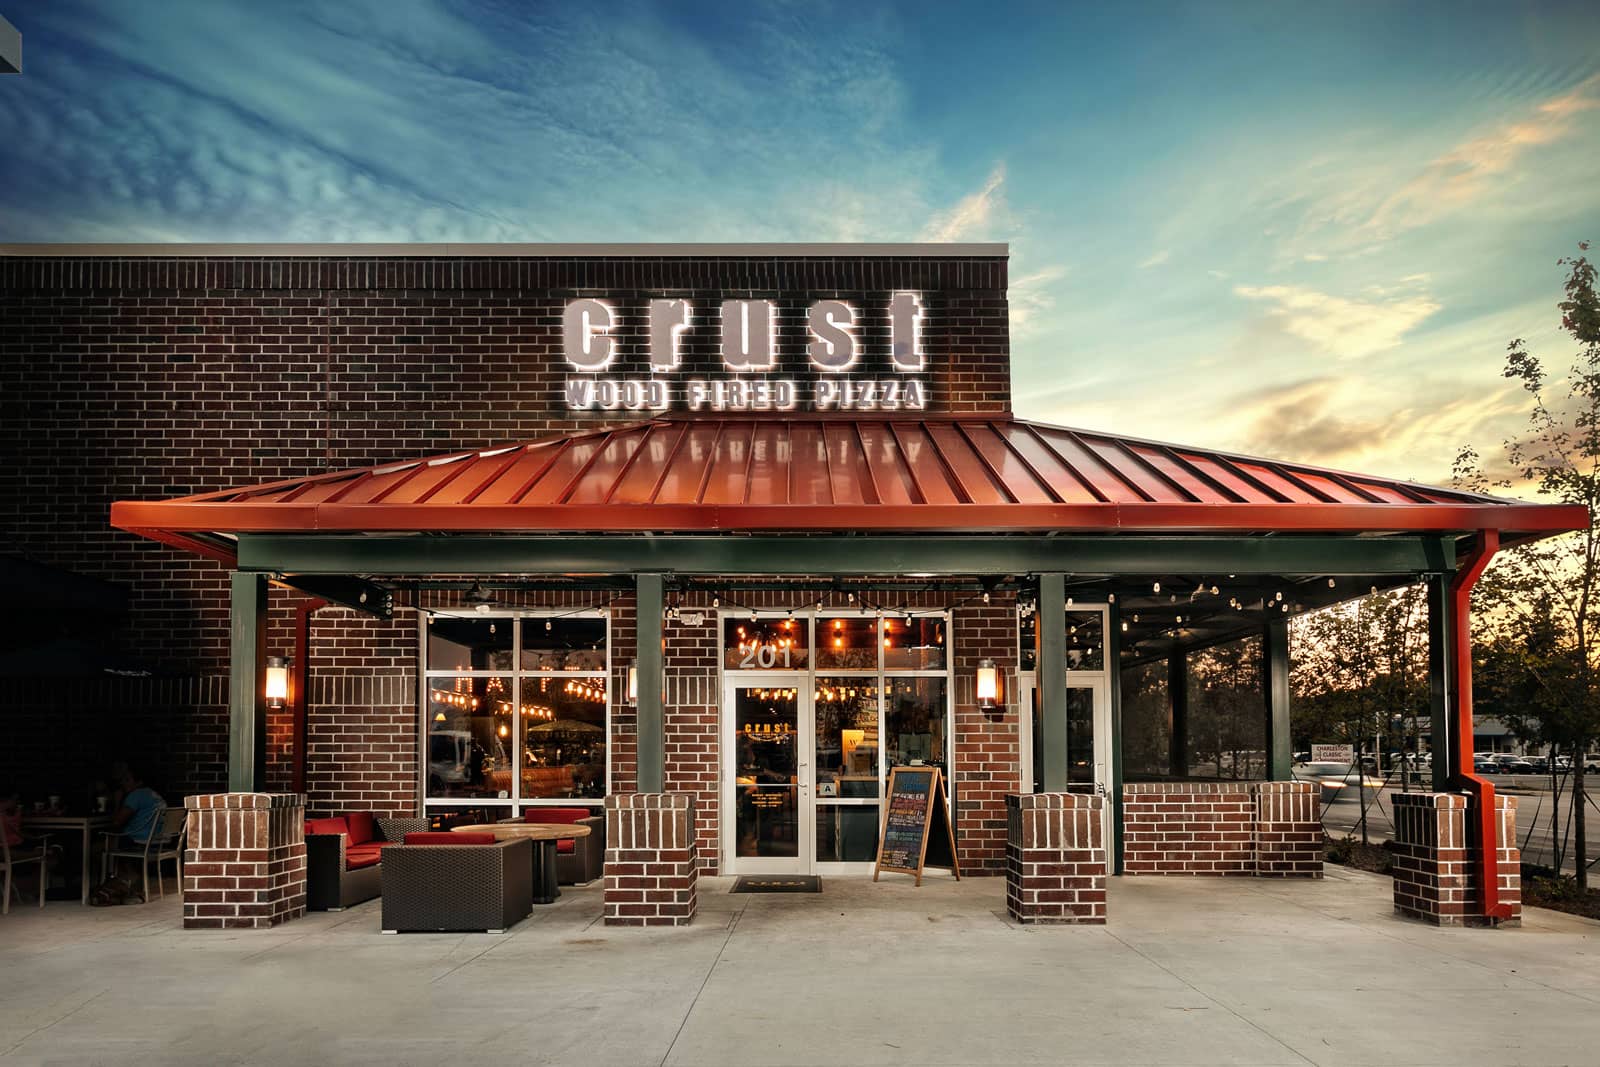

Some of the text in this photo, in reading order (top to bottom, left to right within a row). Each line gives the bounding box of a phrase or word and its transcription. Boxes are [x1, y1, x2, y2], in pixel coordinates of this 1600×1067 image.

[562, 293, 924, 368] crust
[565, 380, 924, 408] WOOD FIRED PIZZA
[739, 645, 791, 668] 201
[744, 722, 790, 733] crust
